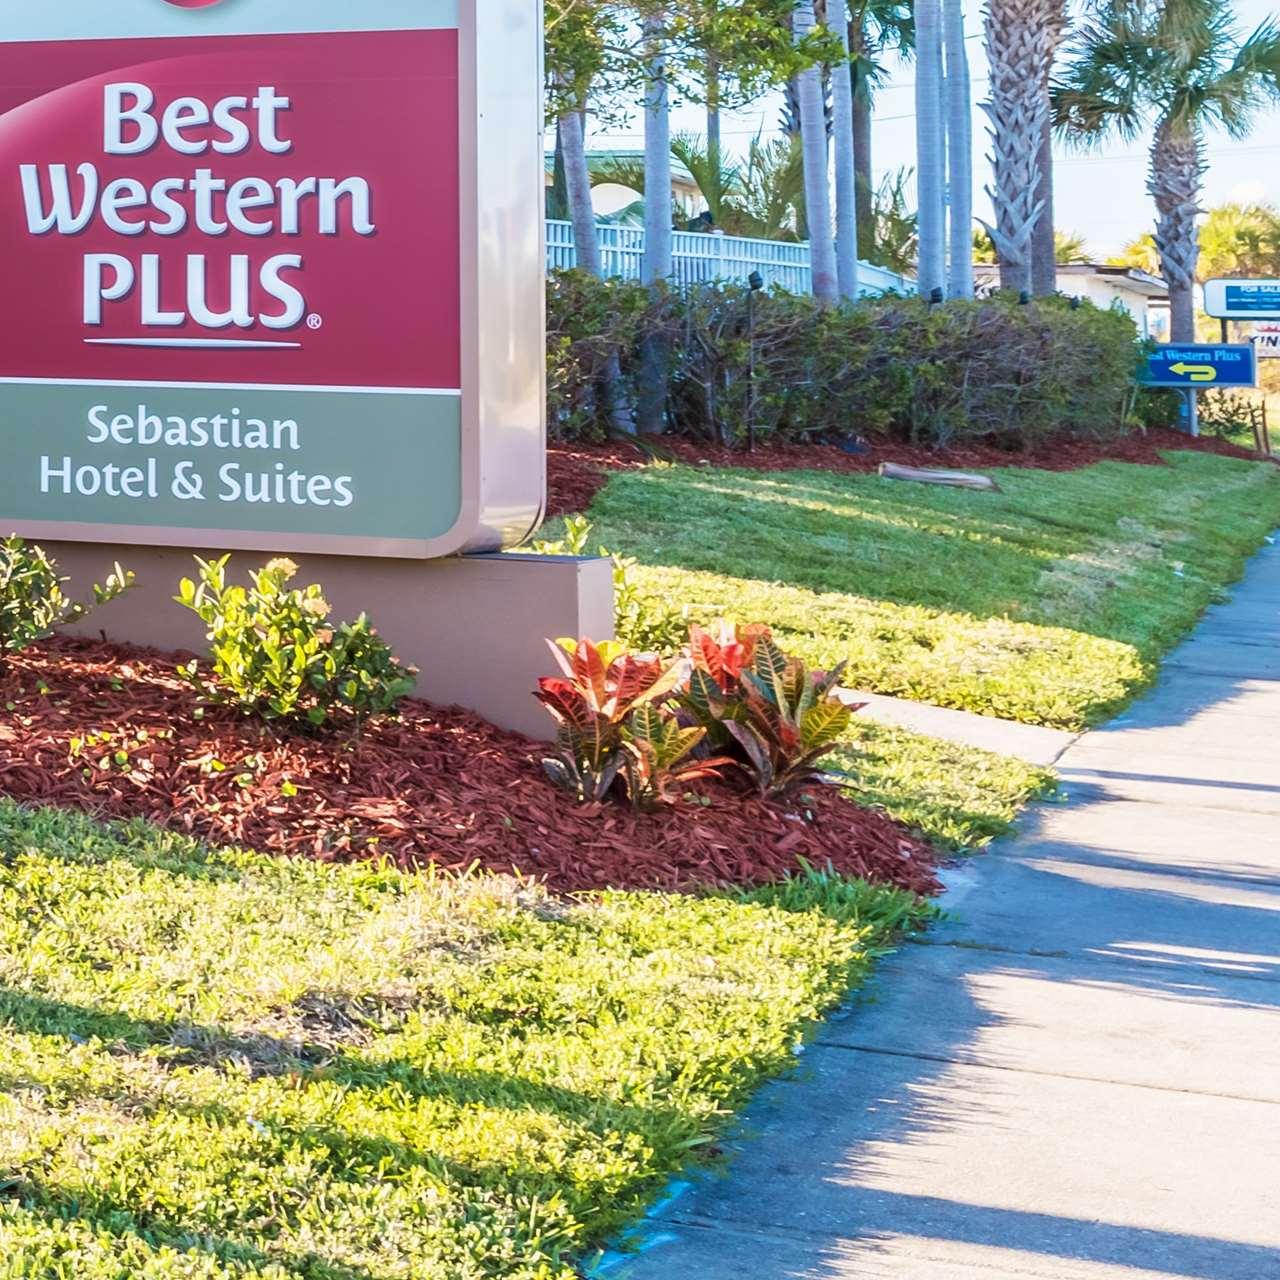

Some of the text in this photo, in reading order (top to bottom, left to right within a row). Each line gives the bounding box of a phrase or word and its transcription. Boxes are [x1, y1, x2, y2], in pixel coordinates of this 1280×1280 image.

[104, 82, 291, 154] Best
[19, 162, 375, 234] Western
[1165, 349, 1212, 361] Western
[1213, 349, 1241, 361] Plus
[87, 405, 300, 450] Sebastian
[40, 456, 354, 507] Hotel & Suites
